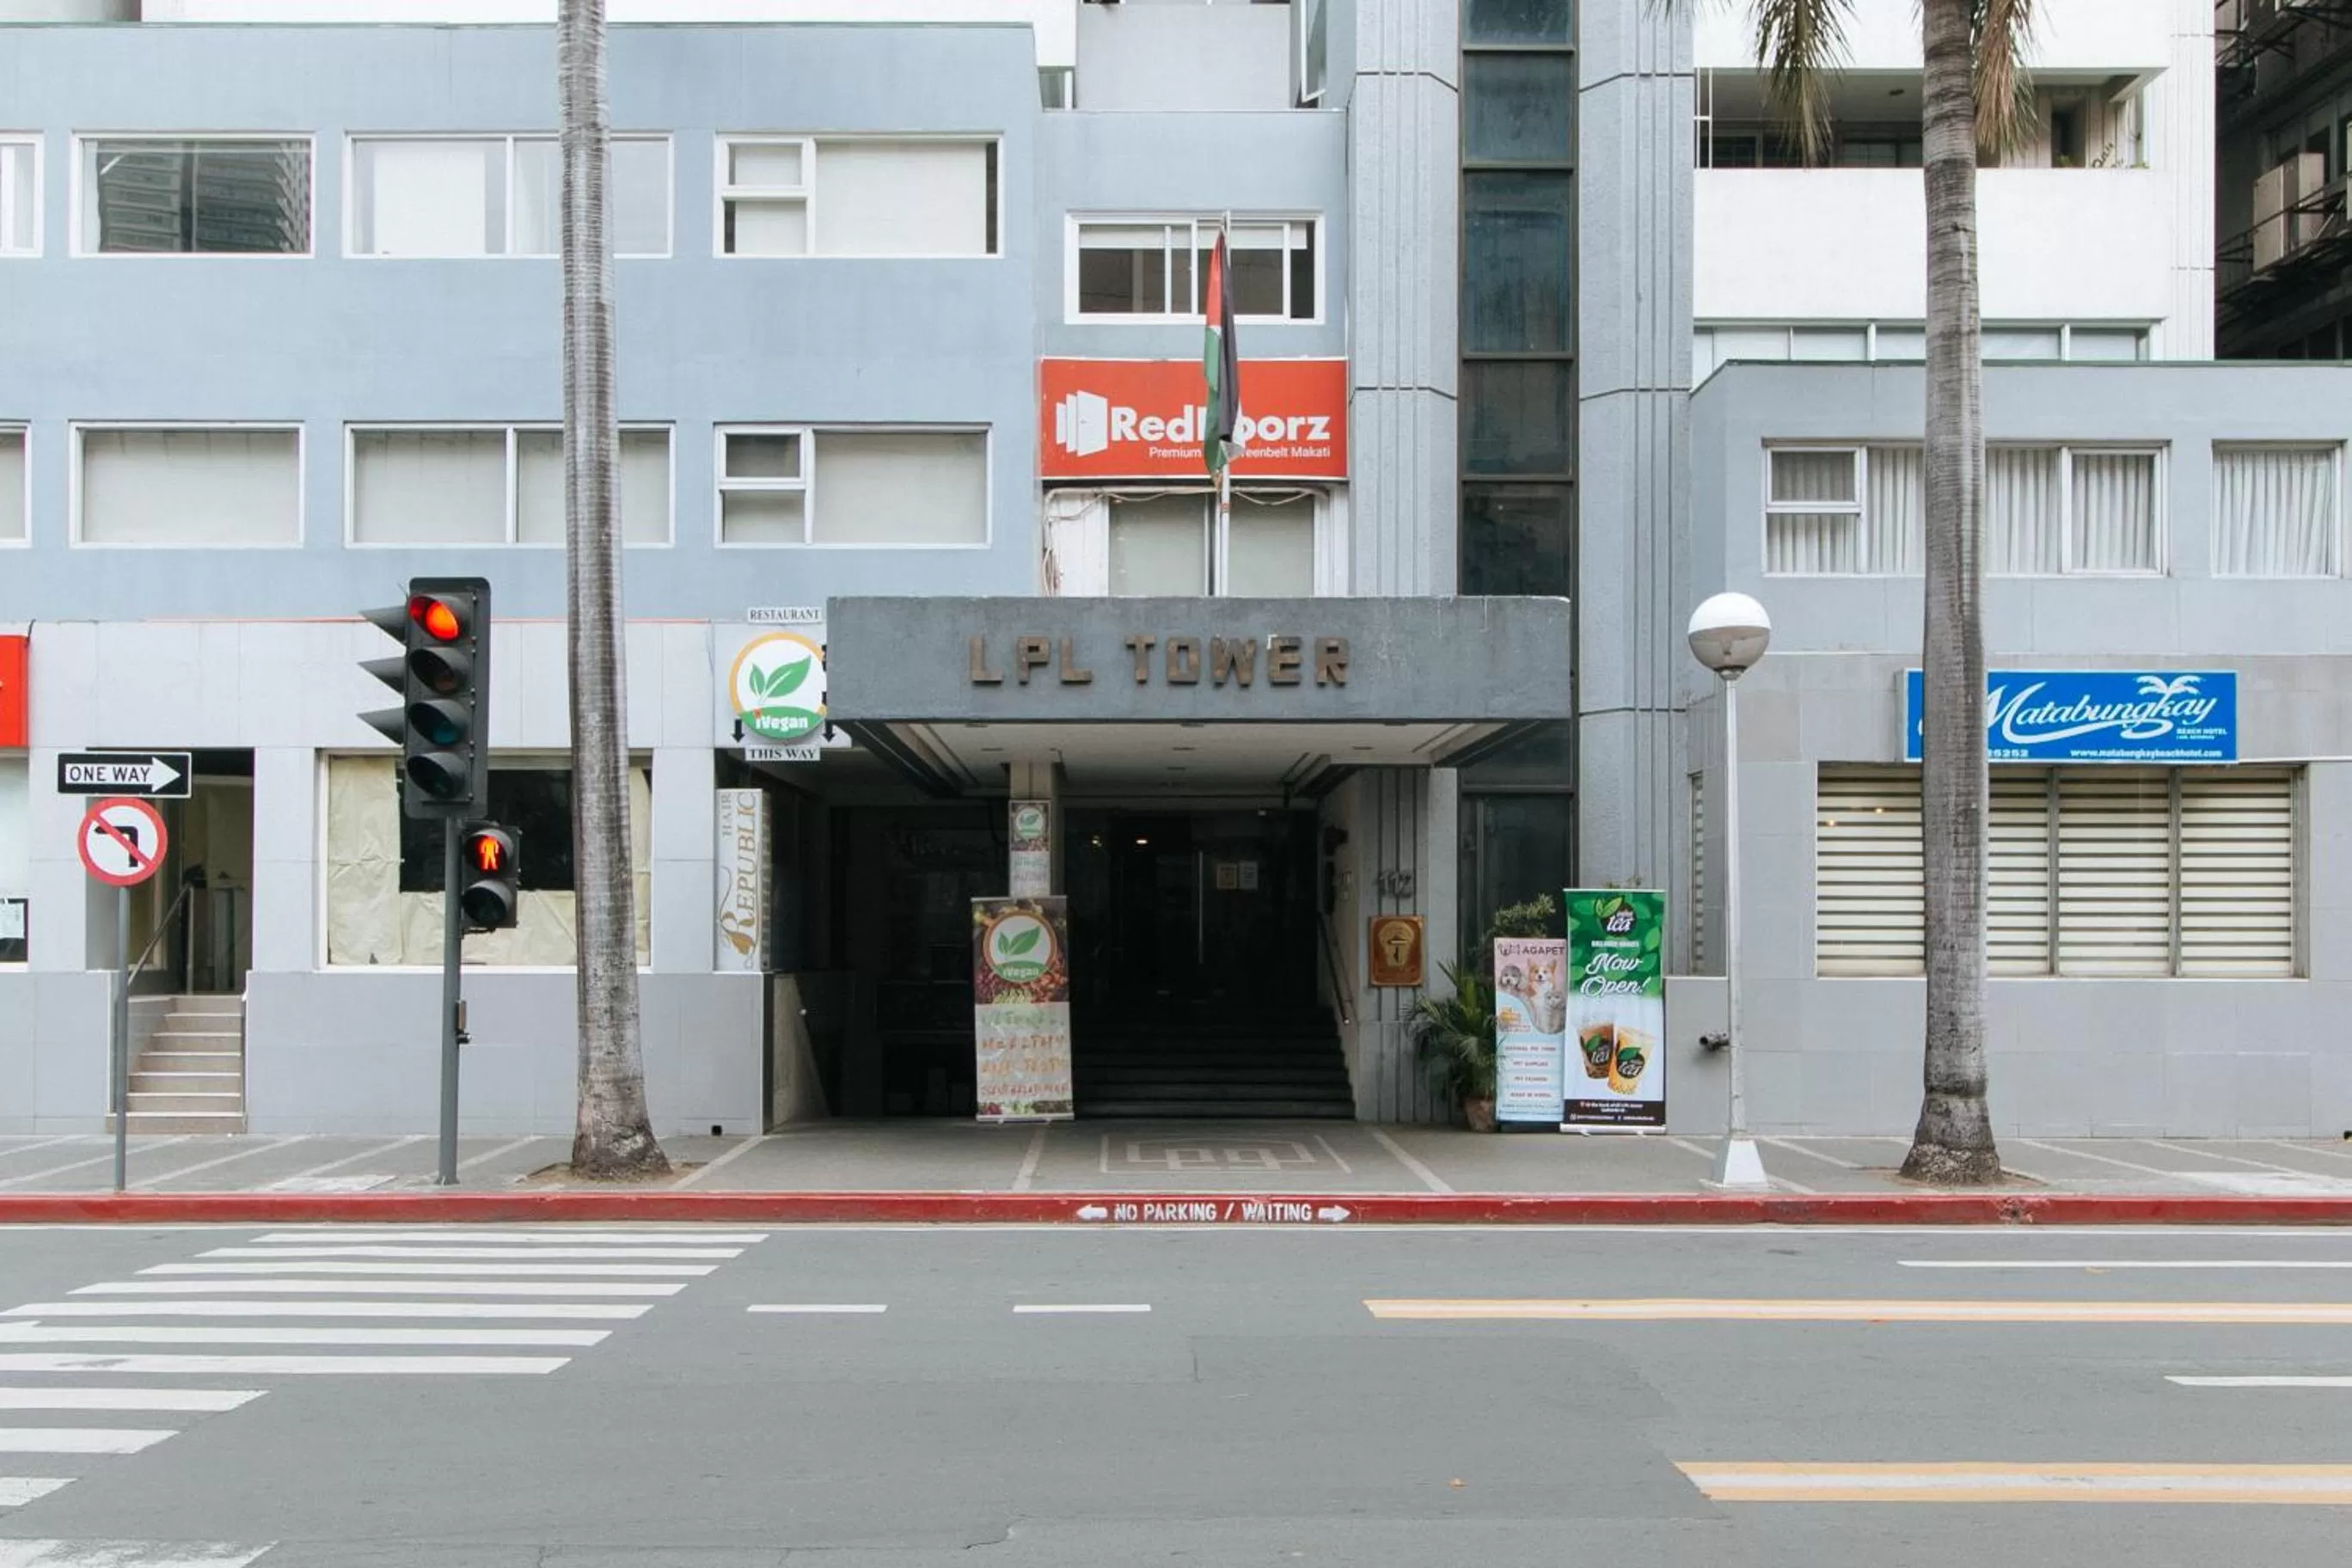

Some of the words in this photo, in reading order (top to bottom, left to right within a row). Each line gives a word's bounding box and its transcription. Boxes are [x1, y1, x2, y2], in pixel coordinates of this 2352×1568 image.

[1112, 405, 1330, 444] Redorz
[1149, 446, 1202, 458] Premium
[1240, 446, 1288, 458] reenbelt
[1291, 446, 1331, 458] Makati
[750, 609, 818, 620] RESTAURANT
[970, 635, 1093, 685] LPL
[1124, 634, 1350, 688] TOWER
[755, 709, 809, 732] iVegan
[1988, 681, 2218, 744] Matabungkay
[750, 749, 782, 759] THIS
[786, 748, 816, 759] WAY
[70, 766, 106, 781] ONE
[113, 767, 151, 782] WAY
[720, 791, 756, 956] REPUBLIC
[1522, 946, 1565, 955] AGAPET
[1585, 952, 1644, 975] Now
[1580, 976, 1651, 996] Open!
[1115, 1204, 1137, 1221] NO
[1143, 1204, 1216, 1221] PARKING
[1224, 1203, 1234, 1220] /
[1241, 1204, 1313, 1221] WAITING
